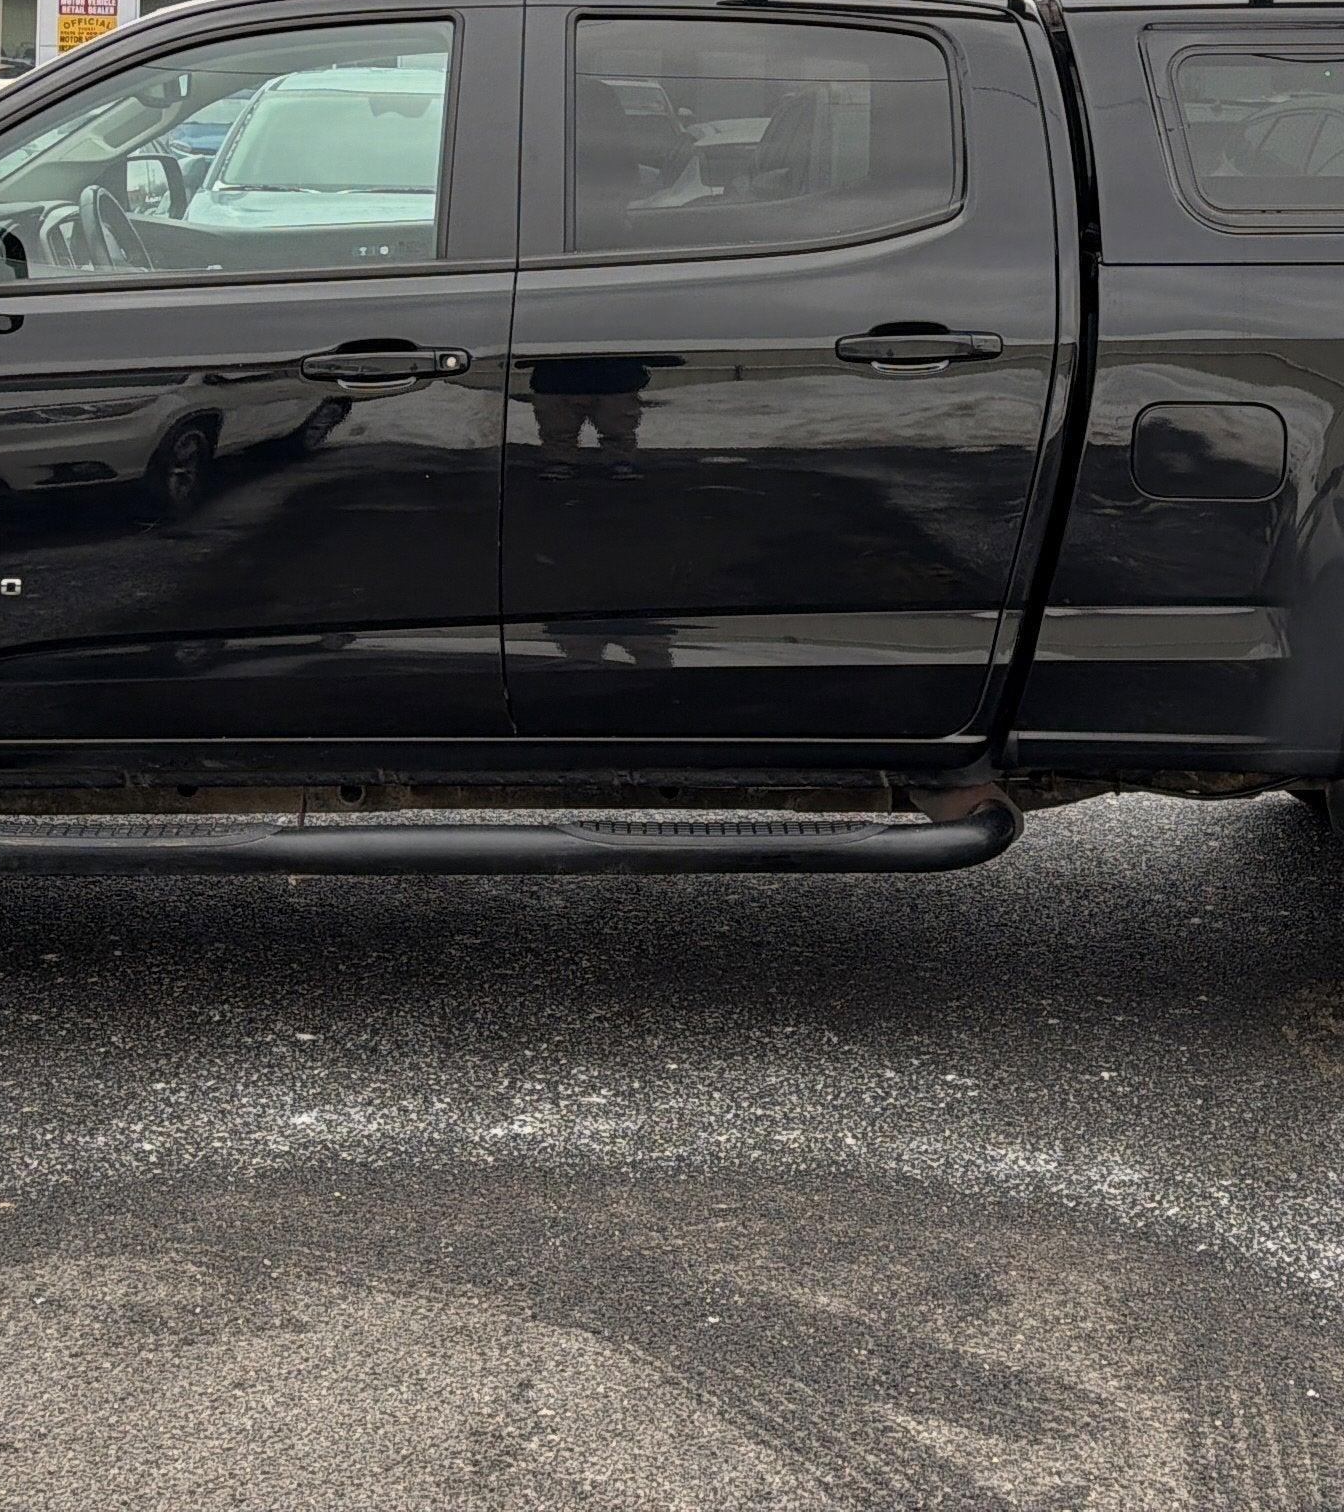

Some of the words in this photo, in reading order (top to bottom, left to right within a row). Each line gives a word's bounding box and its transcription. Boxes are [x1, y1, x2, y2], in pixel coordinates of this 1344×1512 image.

[61, 6, 85, 14] RETAIL
[88, 6, 114, 14] DEALER
[63, 18, 110, 29] OFFICIAL
[60, 35, 83, 43] MOTOR
